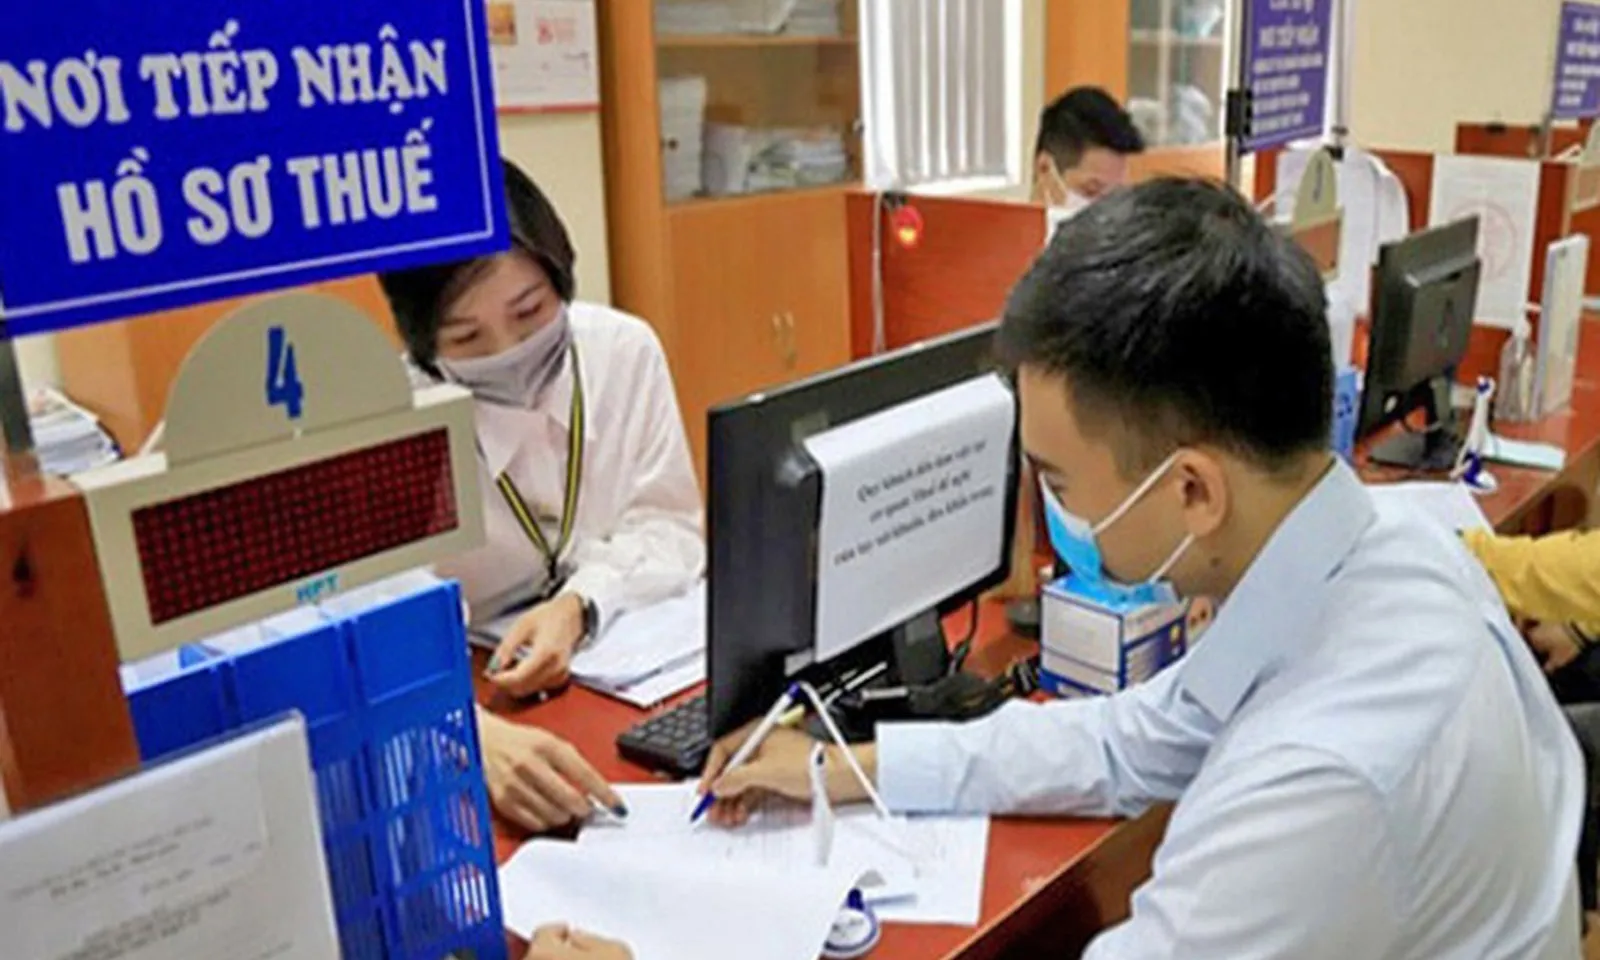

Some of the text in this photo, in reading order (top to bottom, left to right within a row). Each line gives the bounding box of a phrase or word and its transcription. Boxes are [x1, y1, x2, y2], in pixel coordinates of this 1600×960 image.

[0, 19, 448, 132] NƠI TIẾP NHẬN
[57, 117, 438, 264] HỒ SƠ THUẾ
[266, 326, 304, 419] 4
